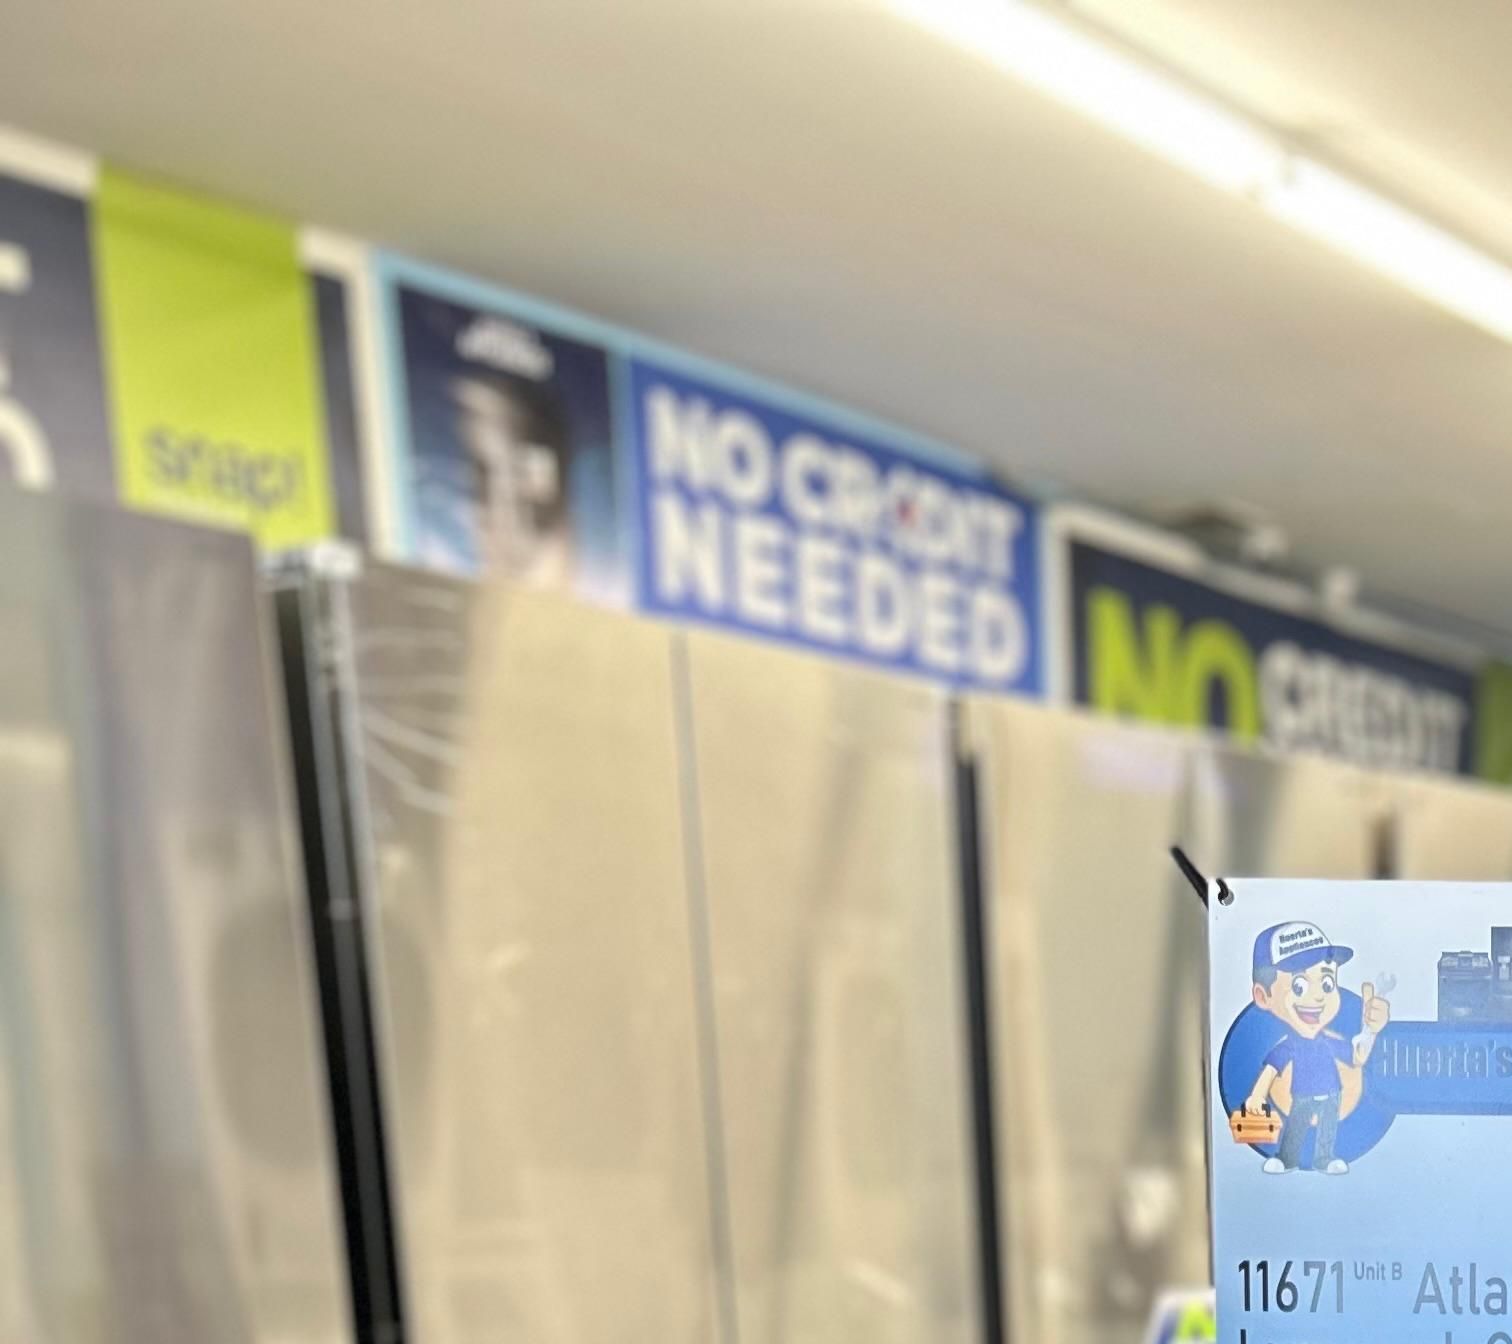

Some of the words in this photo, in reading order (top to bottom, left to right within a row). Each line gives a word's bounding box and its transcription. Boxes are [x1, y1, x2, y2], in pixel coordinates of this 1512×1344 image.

[647, 385, 771, 508] NO
[656, 490, 1027, 681] NEEDED
[1088, 588, 1259, 742] NO
[1238, 1260, 1344, 1314] 11671
[1353, 1261, 1387, 1281] Unit
[1391, 1262, 1403, 1281] B
